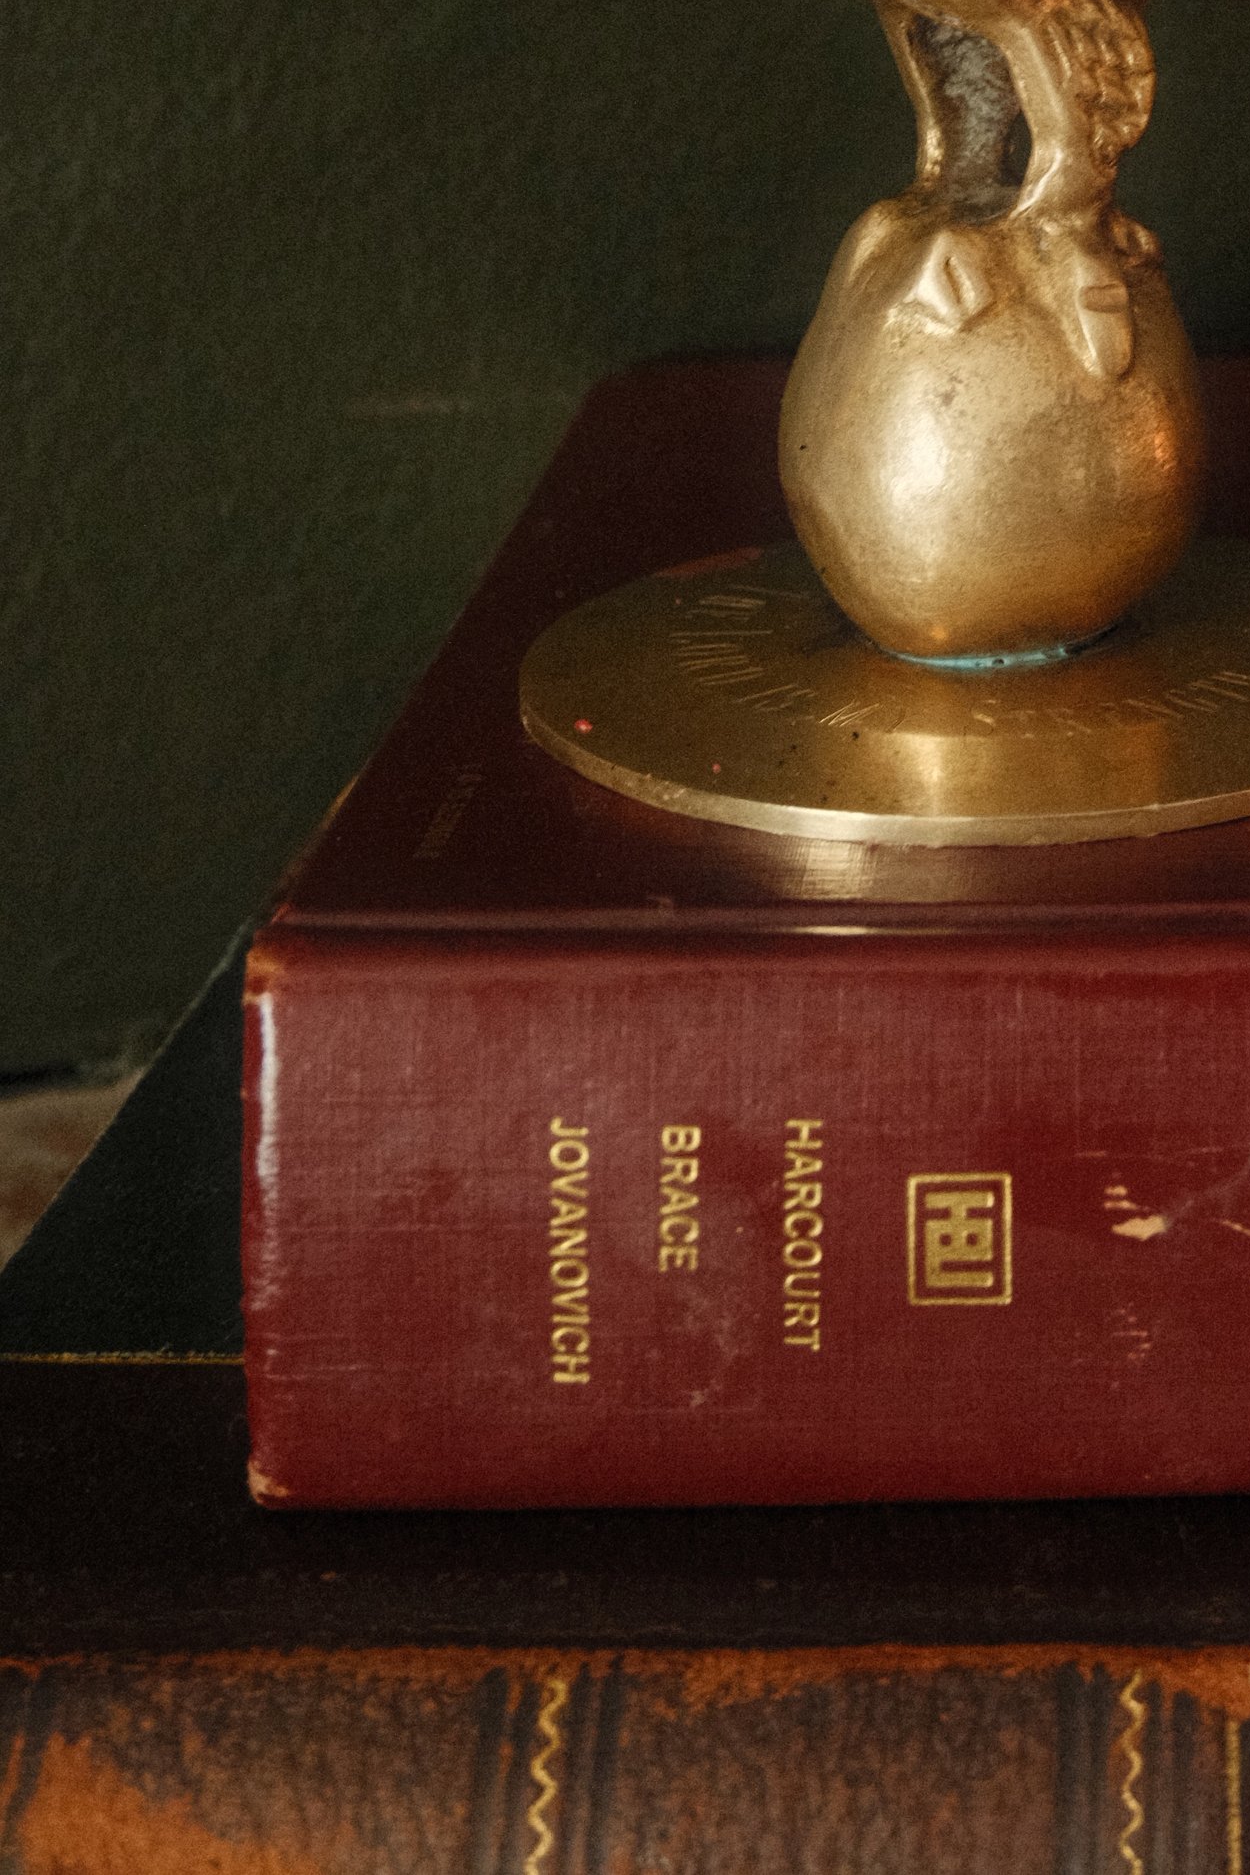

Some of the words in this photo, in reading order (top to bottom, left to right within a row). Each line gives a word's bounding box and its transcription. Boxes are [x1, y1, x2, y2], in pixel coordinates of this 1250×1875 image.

[549, 1115, 591, 1385] JOVANOVICH
[658, 1124, 701, 1272] BRACE
[784, 1116, 825, 1351] HARCOURT
